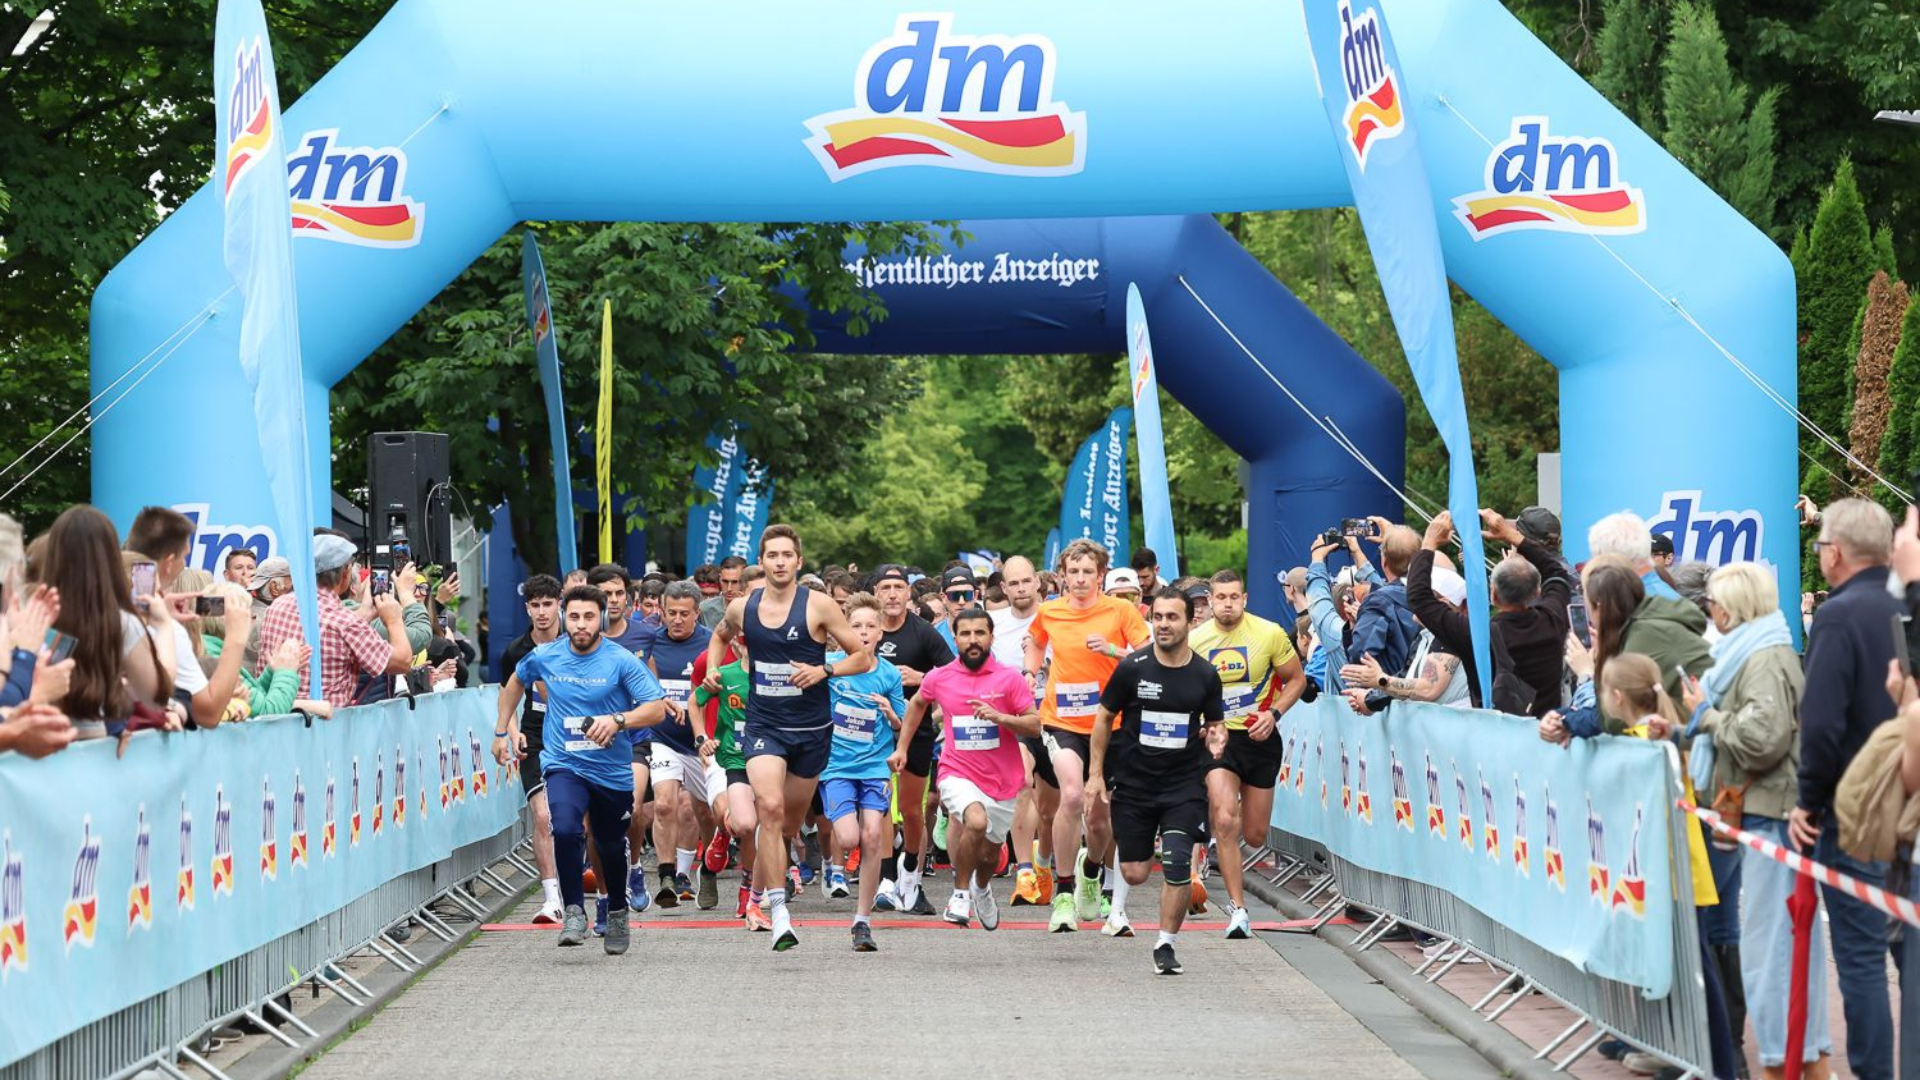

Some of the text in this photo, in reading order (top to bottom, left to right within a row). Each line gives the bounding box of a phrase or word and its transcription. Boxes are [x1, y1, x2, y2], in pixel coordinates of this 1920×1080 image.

[230, 45, 263, 144] dm
[867, 21, 1044, 114] dm
[1344, 6, 1385, 101] dm
[288, 136, 398, 202] dm
[1493, 124, 1611, 194] dm
[988, 252, 1100, 287] Anzeiger
[1102, 420, 1122, 512] Anzeiger
